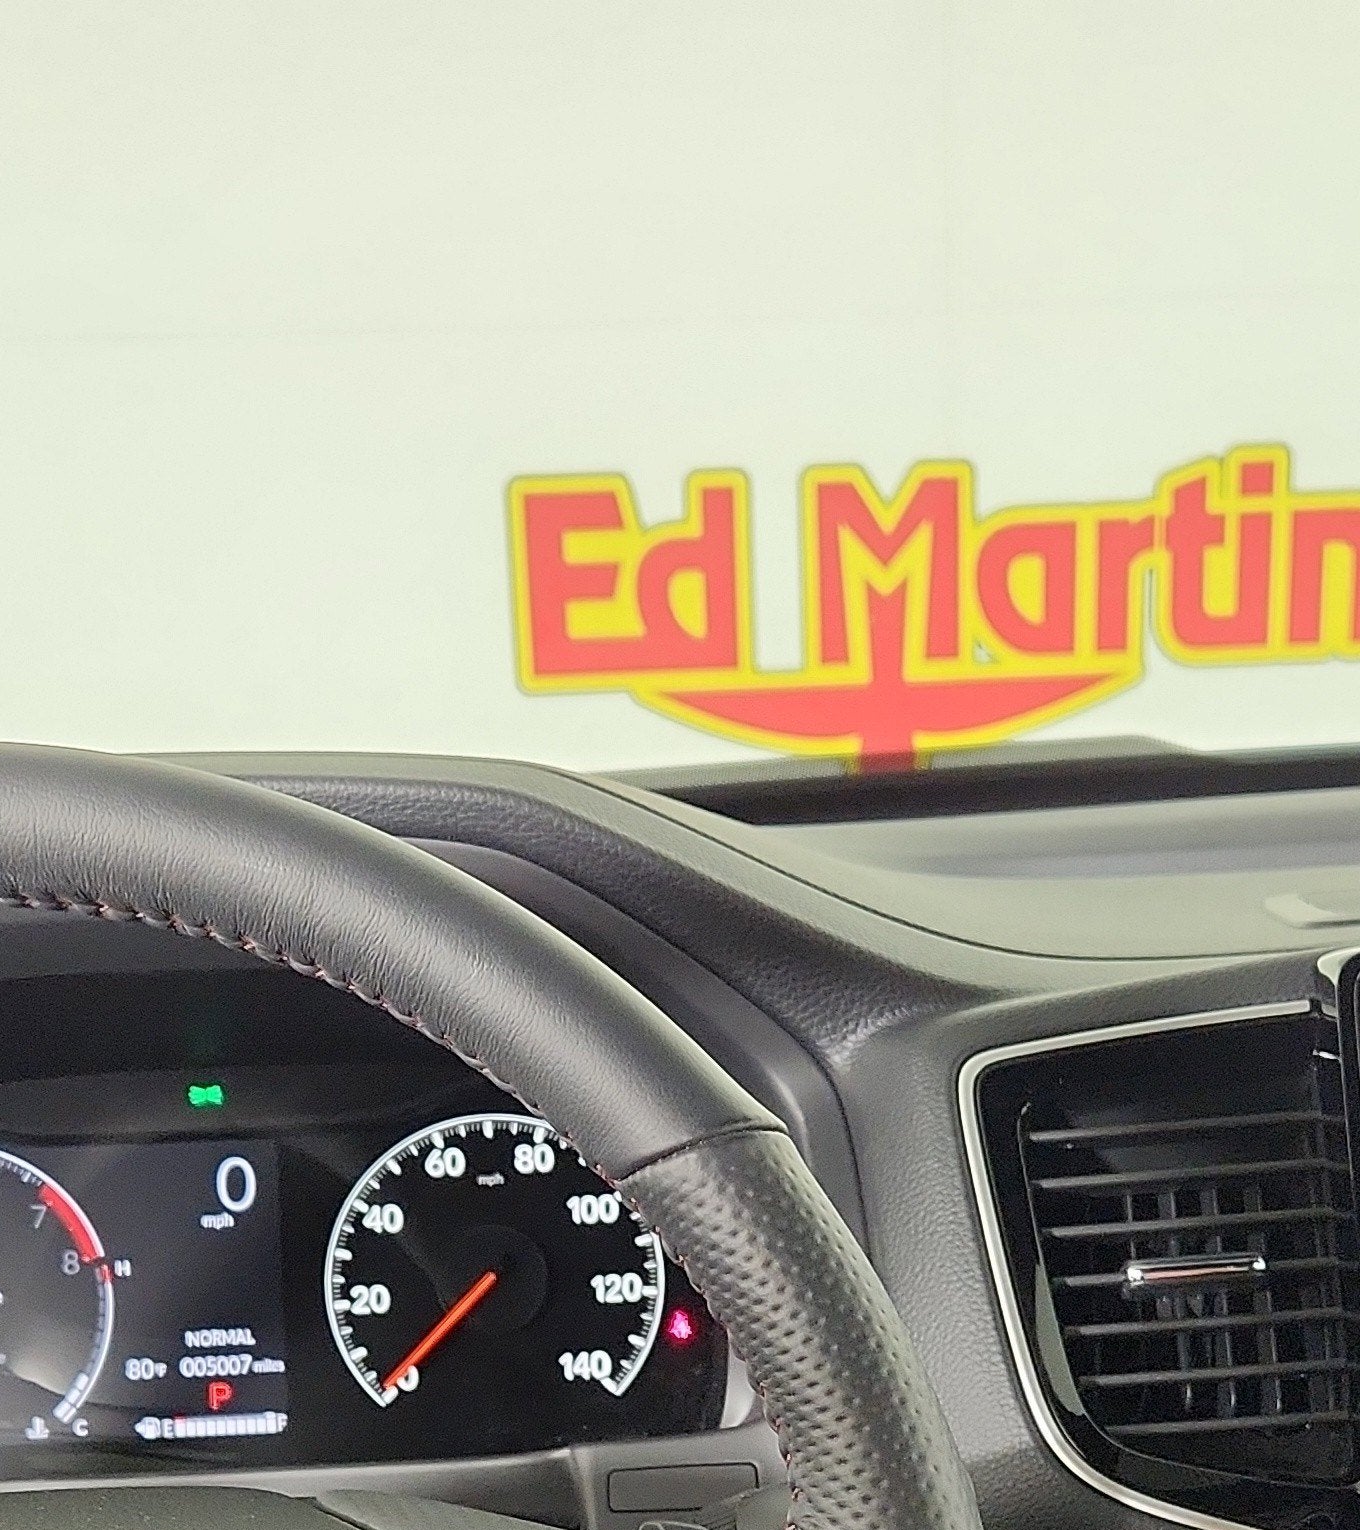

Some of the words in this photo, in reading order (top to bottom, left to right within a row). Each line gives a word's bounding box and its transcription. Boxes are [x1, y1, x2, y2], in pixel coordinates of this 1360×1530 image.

[424, 1146, 466, 1178] 60
[513, 1143, 555, 1175] 80
[215, 1156, 257, 1213] 0
[31, 1205, 48, 1229] 7
[200, 1212, 235, 1232] mph
[362, 1202, 405, 1234] 40
[566, 1193, 620, 1225] 100
[62, 1251, 80, 1275] 8
[349, 1283, 391, 1316] 20
[590, 1272, 642, 1305] 120
[184, 1328, 257, 1348] NORMAL
[178, 1353, 253, 1378] 005007
[252, 1357, 285, 1373] miles
[397, 1365, 419, 1392] 0
[558, 1349, 612, 1381] 140
[208, 1381, 233, 1410] P
